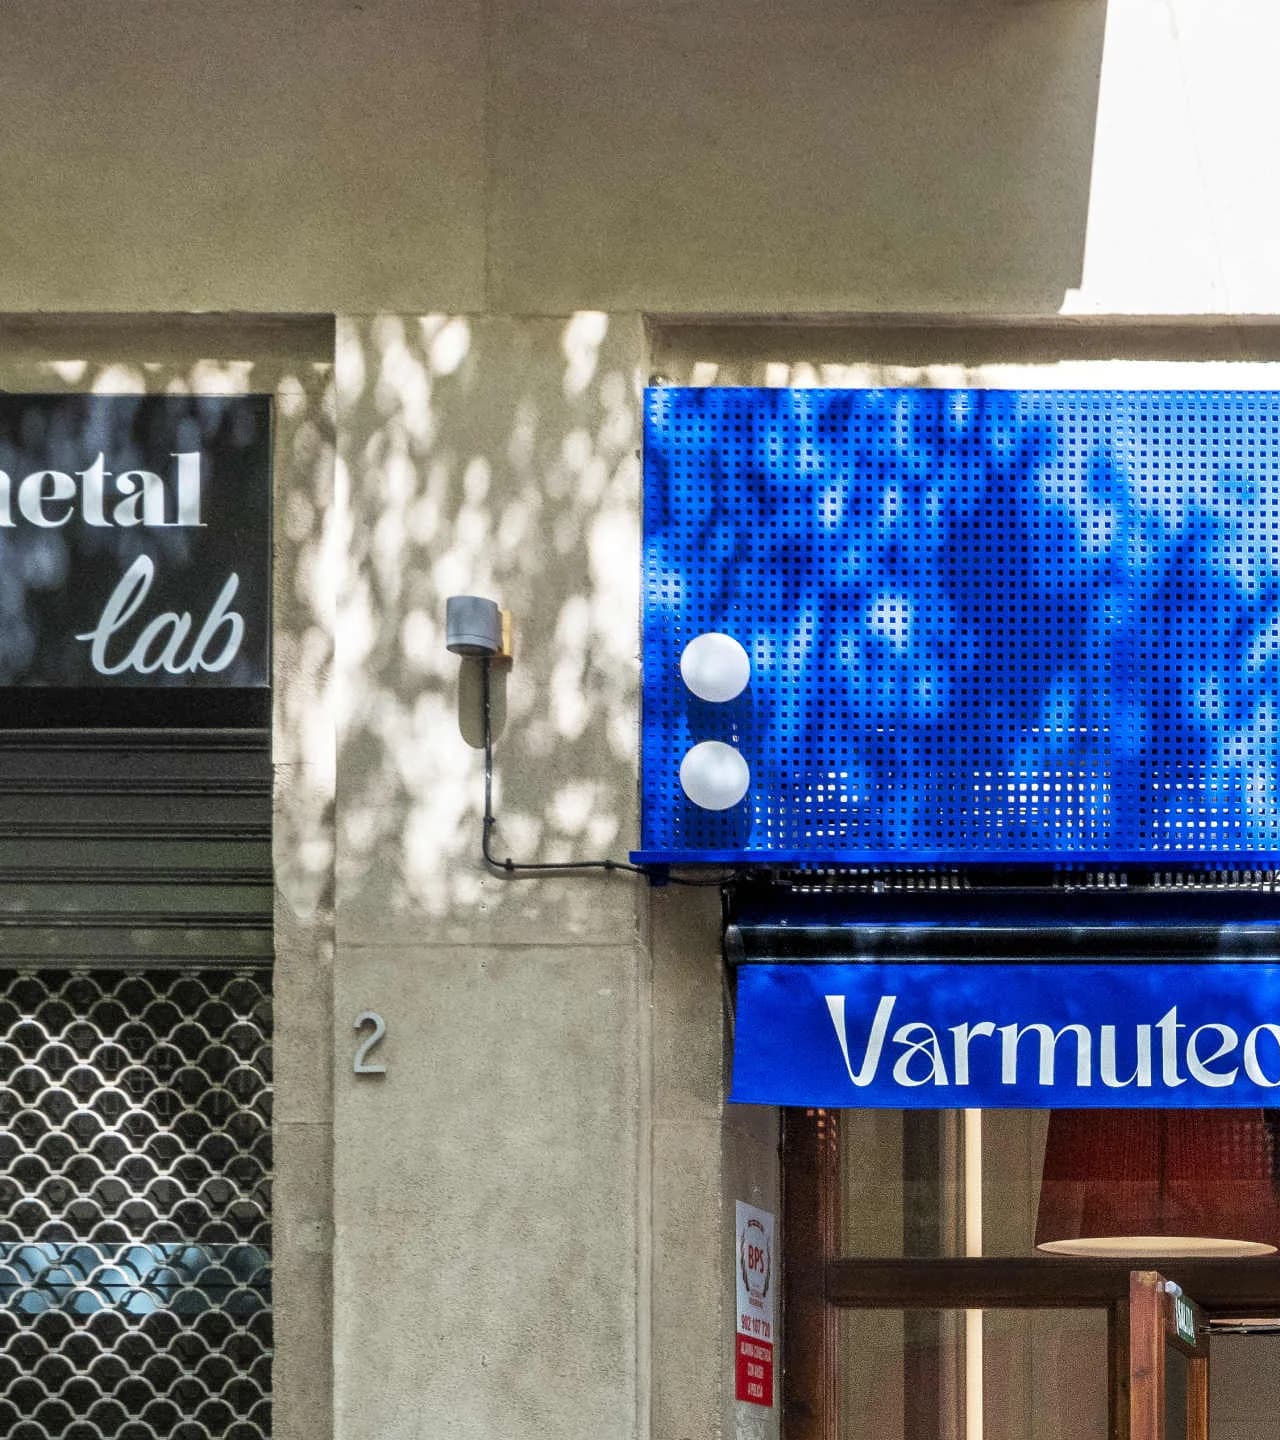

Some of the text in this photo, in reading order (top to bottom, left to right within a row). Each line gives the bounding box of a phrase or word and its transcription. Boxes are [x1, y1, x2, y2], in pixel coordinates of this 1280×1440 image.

[0, 451, 208, 528] etal
[75, 554, 245, 675] lab
[353, 1011, 386, 1073] 2
[748, 1245, 764, 1273] BPS
